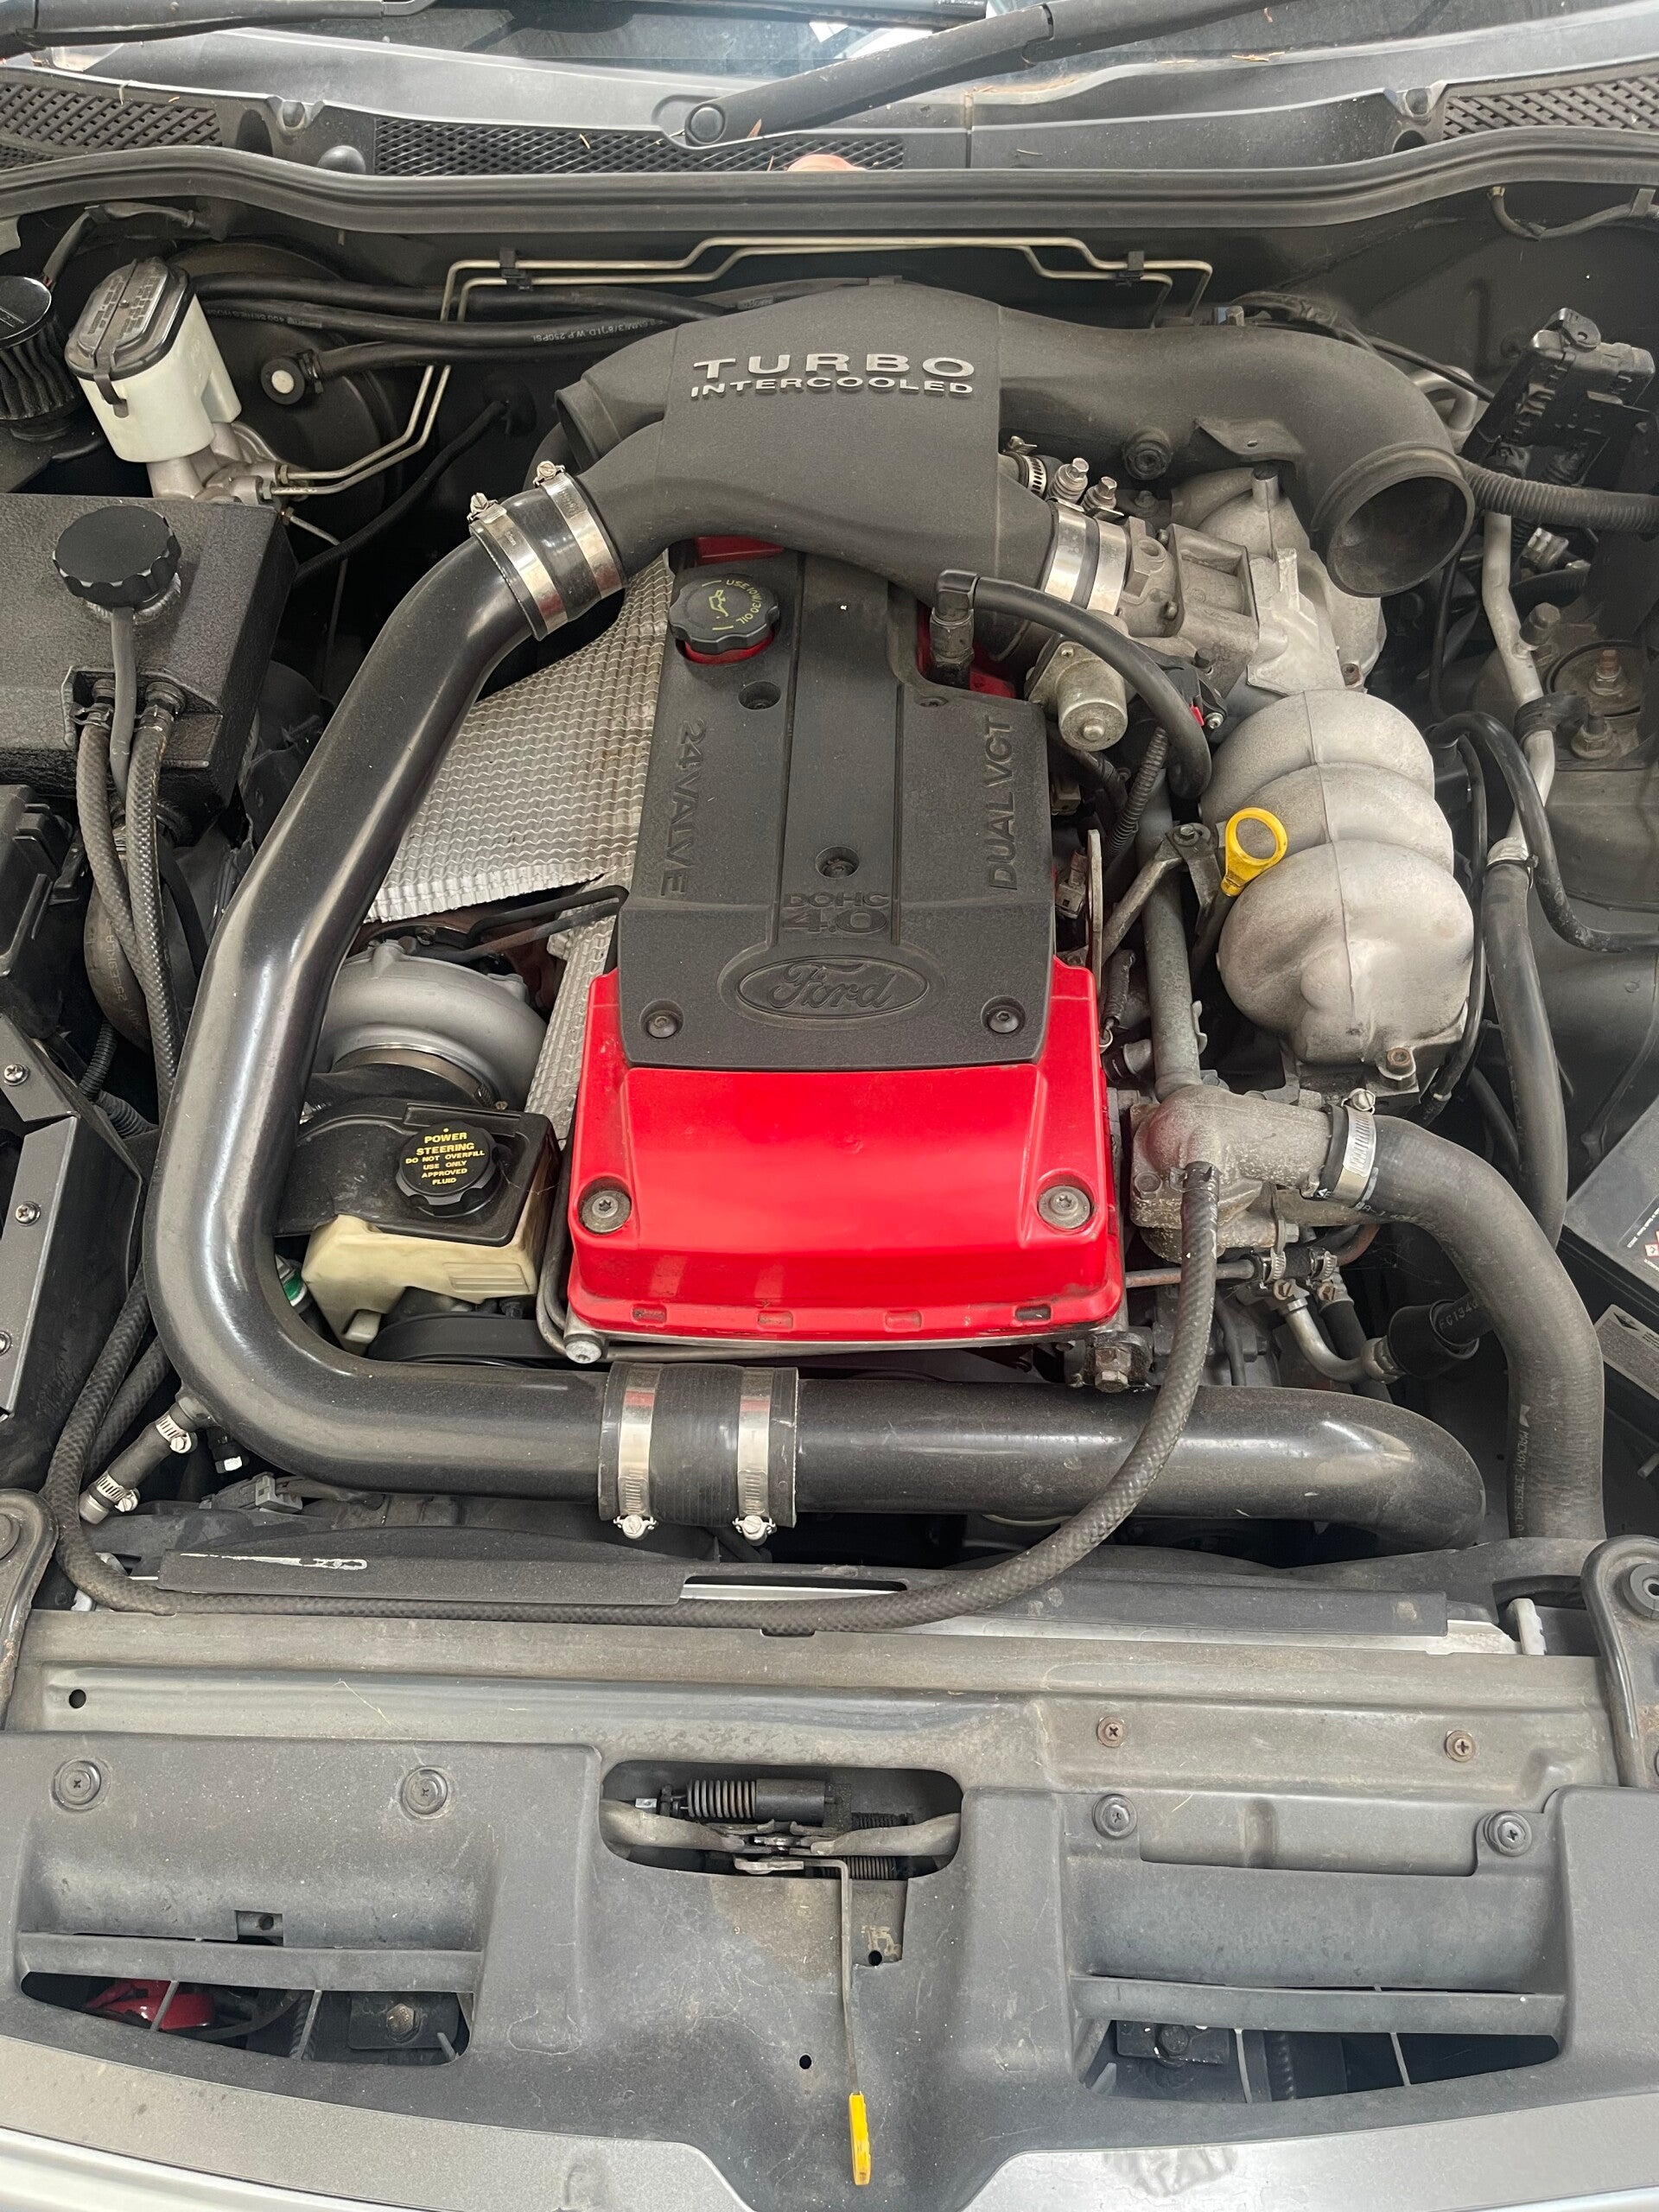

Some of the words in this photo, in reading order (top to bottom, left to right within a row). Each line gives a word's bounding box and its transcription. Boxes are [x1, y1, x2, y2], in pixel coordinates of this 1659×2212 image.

[692, 353, 976, 380] TURBO
[690, 377, 975, 399] INTERCOOLED
[727, 579, 750, 589] USE
[735, 613, 754, 625] OIL
[983, 715, 1014, 789] VCT
[983, 791, 1018, 891] DUAL
[782, 891, 891, 908] DOHC
[782, 907, 888, 934] 4.0
[767, 962, 897, 1009] Ford
[423, 1132, 467, 1143] POWER
[416, 1142, 475, 1155] STEERING
[444, 1149, 486, 1160] OVERFILL
[421, 1167, 468, 1178] APPROVED
